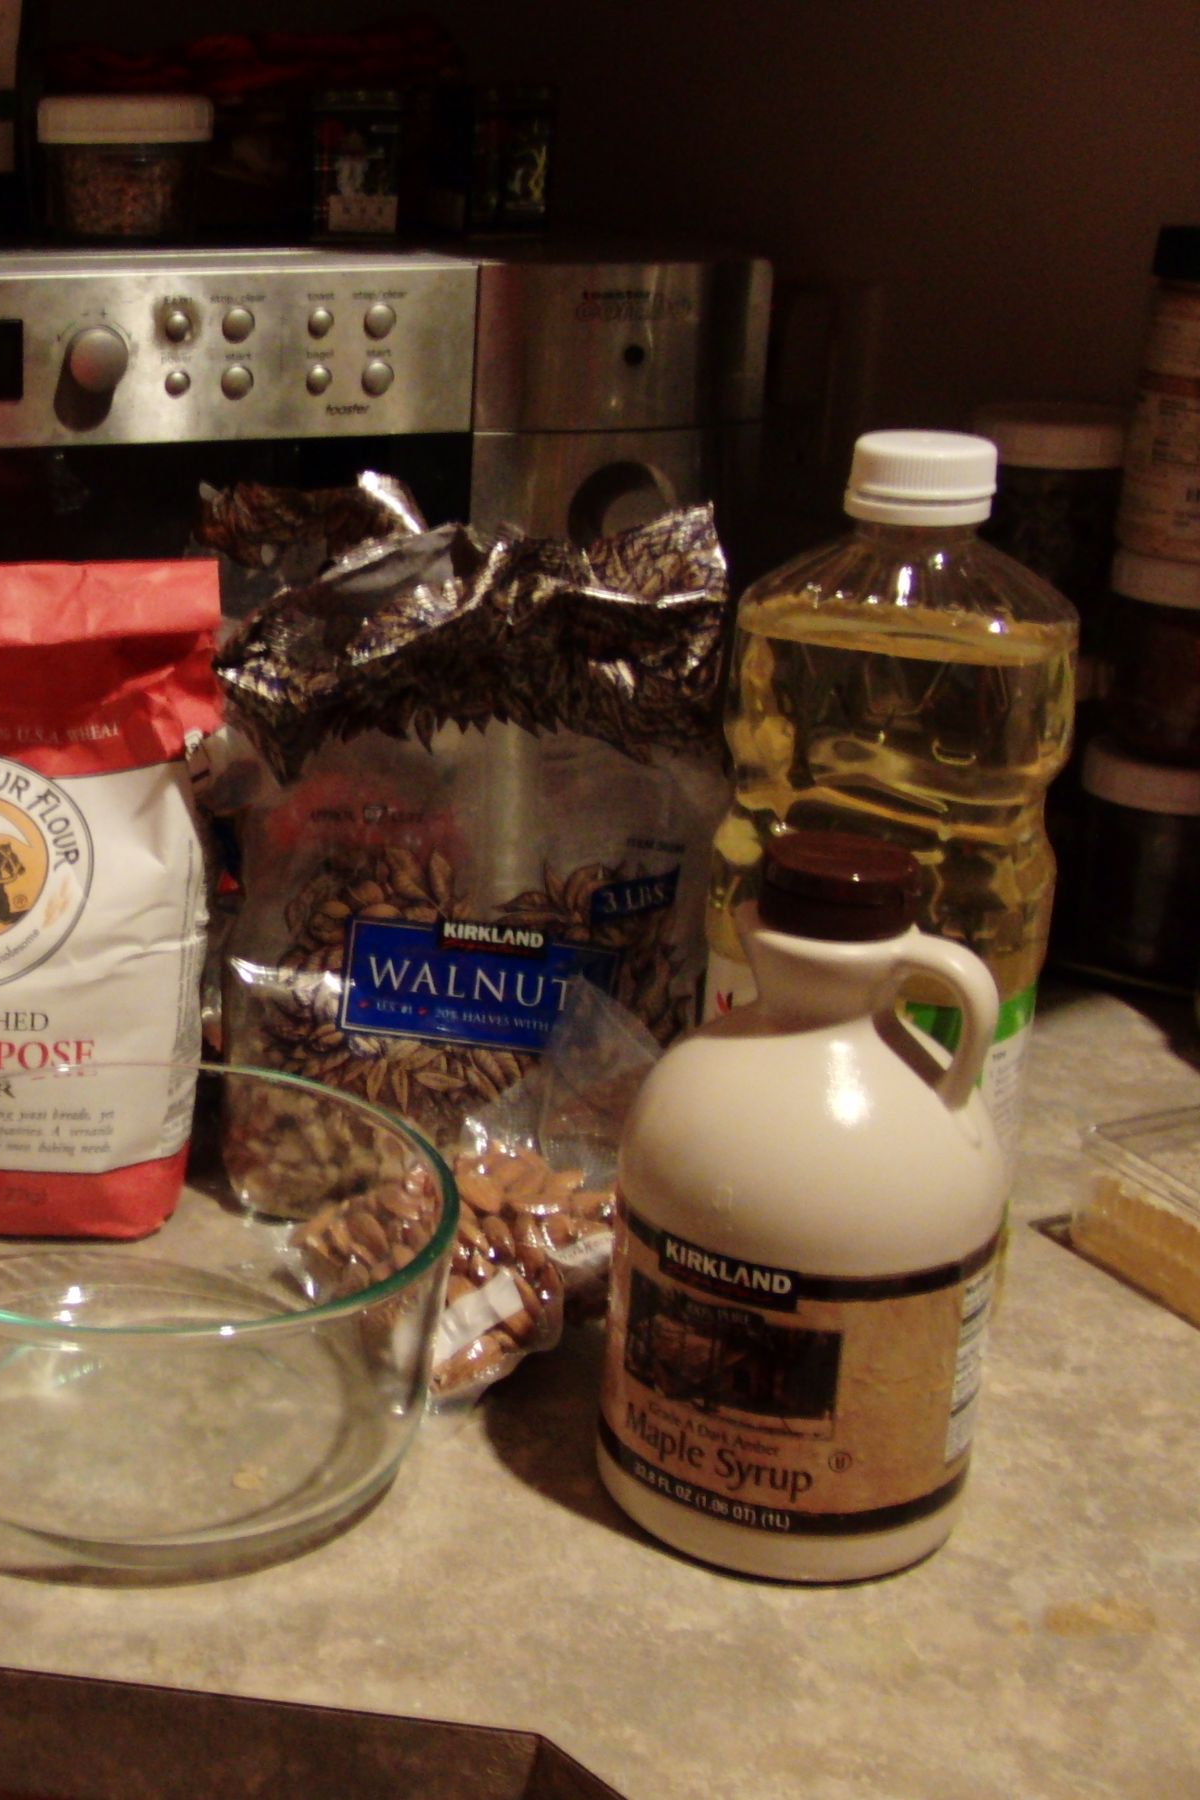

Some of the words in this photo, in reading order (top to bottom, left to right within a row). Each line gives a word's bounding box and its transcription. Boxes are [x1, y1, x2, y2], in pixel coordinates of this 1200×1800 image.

[27, 788, 80, 870] FLOUR
[442, 921, 545, 950] KIRKLAND
[665, 1237, 793, 1295] KIRKLAND
[626, 1401, 706, 1469] Maple
[714, 1448, 813, 1504] Syrup
[657, 1476, 673, 1495] FL
[675, 1485, 693, 1502] OZ
